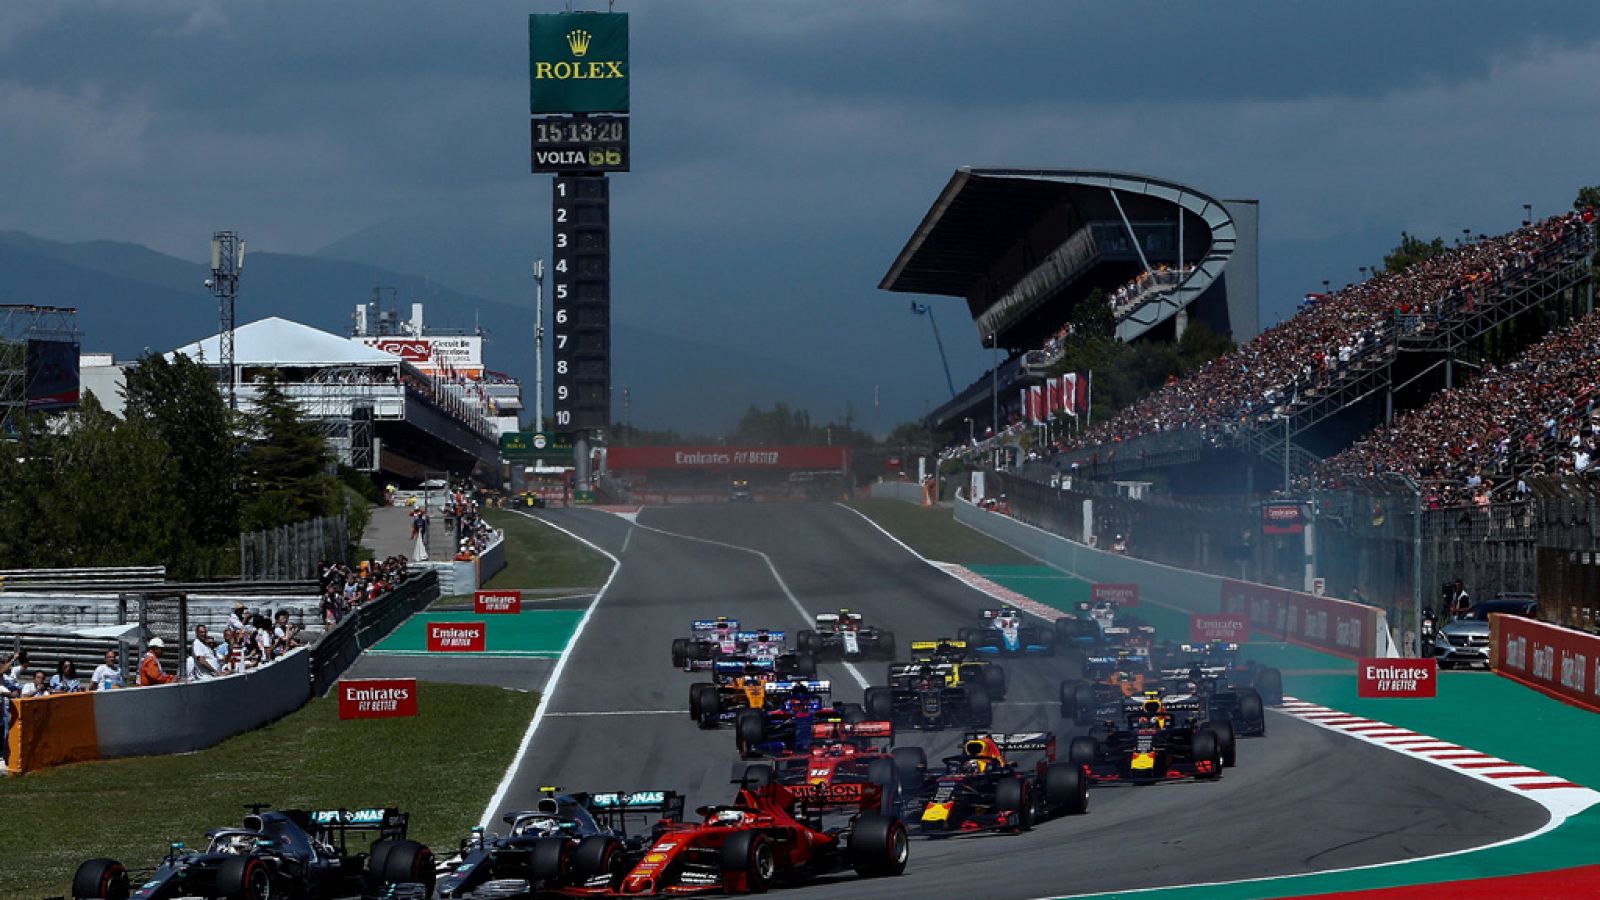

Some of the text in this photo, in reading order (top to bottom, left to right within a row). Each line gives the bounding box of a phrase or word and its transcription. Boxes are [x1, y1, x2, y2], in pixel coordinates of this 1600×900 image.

[535, 61, 624, 79] ROLEX
[537, 122, 622, 142] 15:13:20
[536, 148, 621, 166] VOLTA 66
[557, 183, 565, 196] 1
[557, 208, 567, 222] 2
[557, 234, 567, 247] 3
[556, 259, 568, 272] 4
[557, 285, 567, 298] 5
[556, 310, 567, 323] 6
[557, 335, 567, 349] 7
[557, 360, 568, 374] 8
[557, 386, 568, 399] 9
[556, 411, 570, 425] 10
[675, 451, 730, 464] Emirates
[479, 594, 517, 604] Emirates
[1196, 618, 1243, 630] Emirates
[432, 627, 479, 638] Emirates
[1366, 665, 1429, 680] Emirates
[1377, 680, 1417, 692] FLY BETTER
[347, 687, 409, 701] Emirates
[359, 700, 398, 712] FLY BETTER
